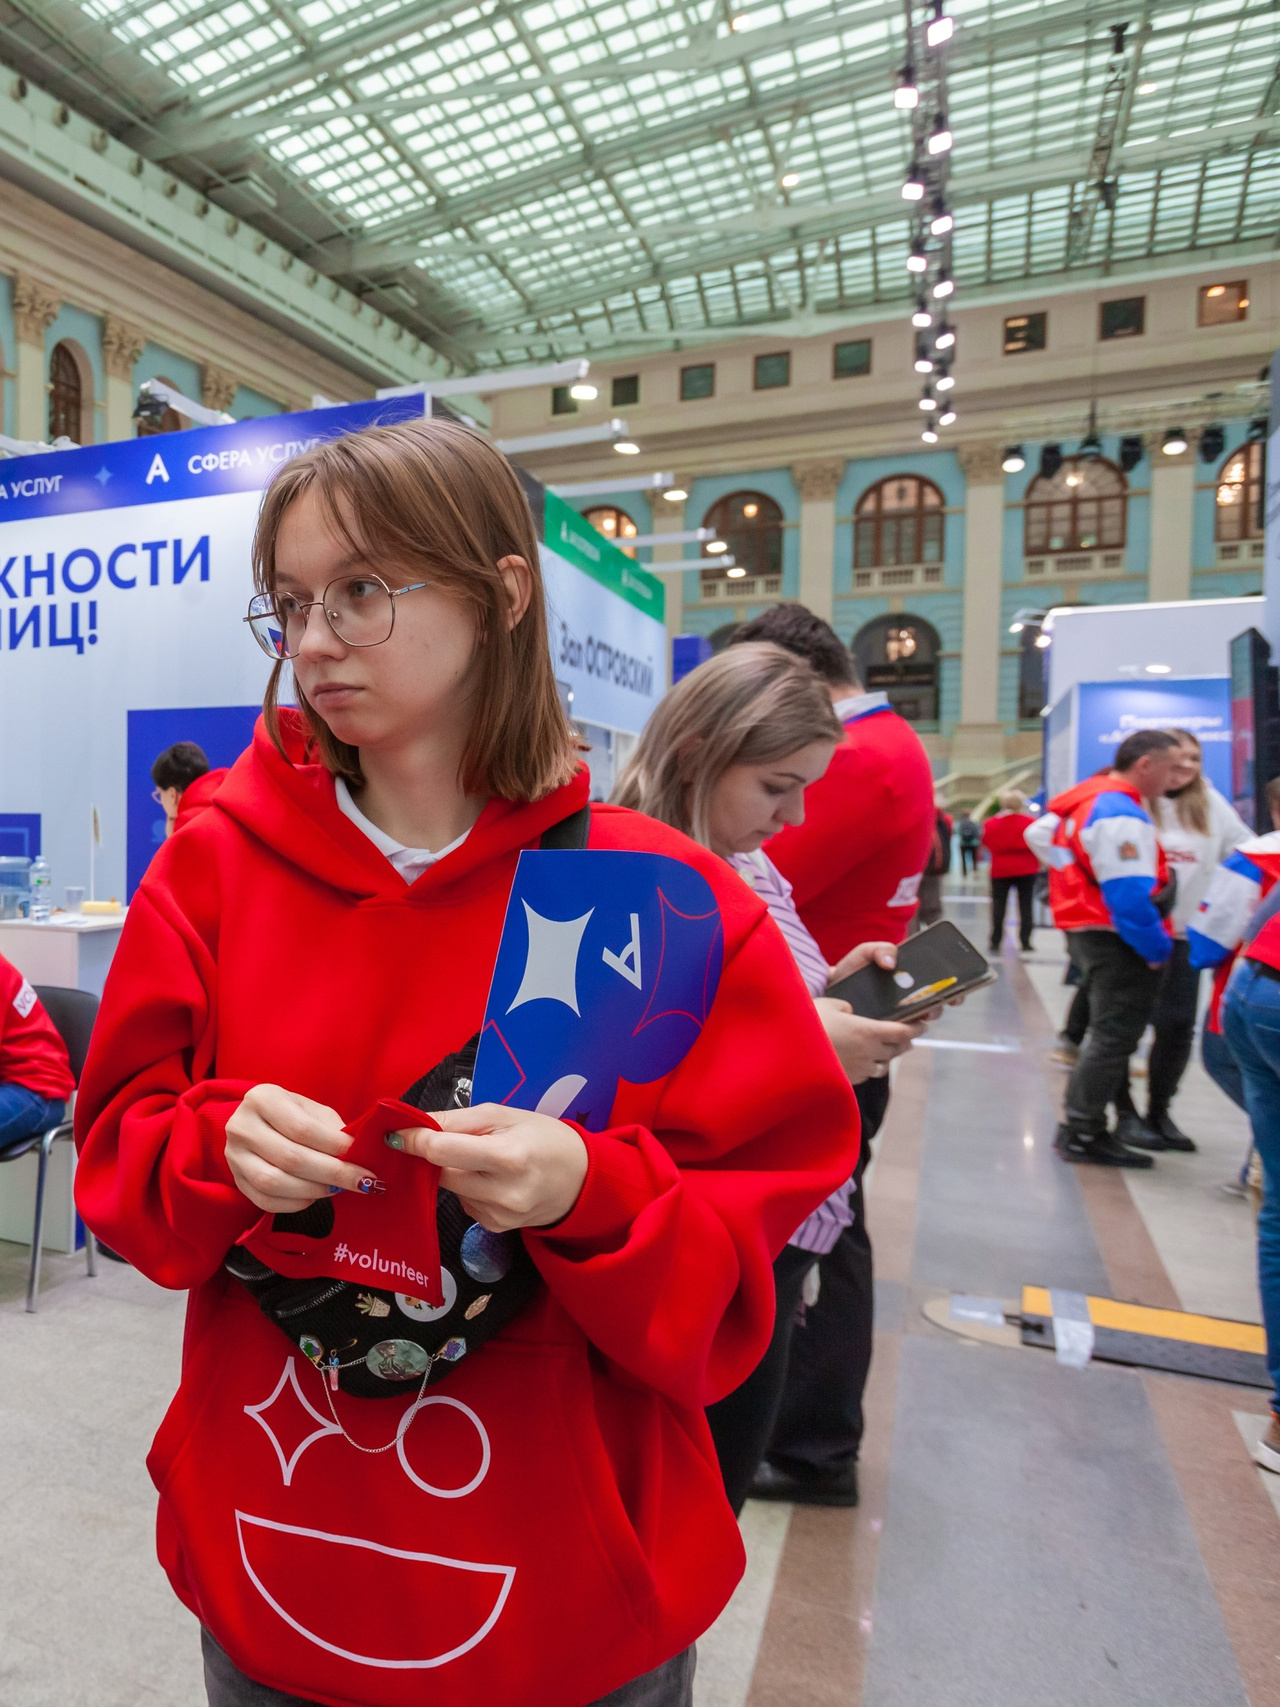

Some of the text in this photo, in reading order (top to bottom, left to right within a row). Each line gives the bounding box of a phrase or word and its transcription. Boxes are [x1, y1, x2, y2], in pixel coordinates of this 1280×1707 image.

[187, 449, 253, 475] СФЕРА
[10, 475, 64, 498] УСЛУГ
[333, 1242, 429, 1289] #volunteer
